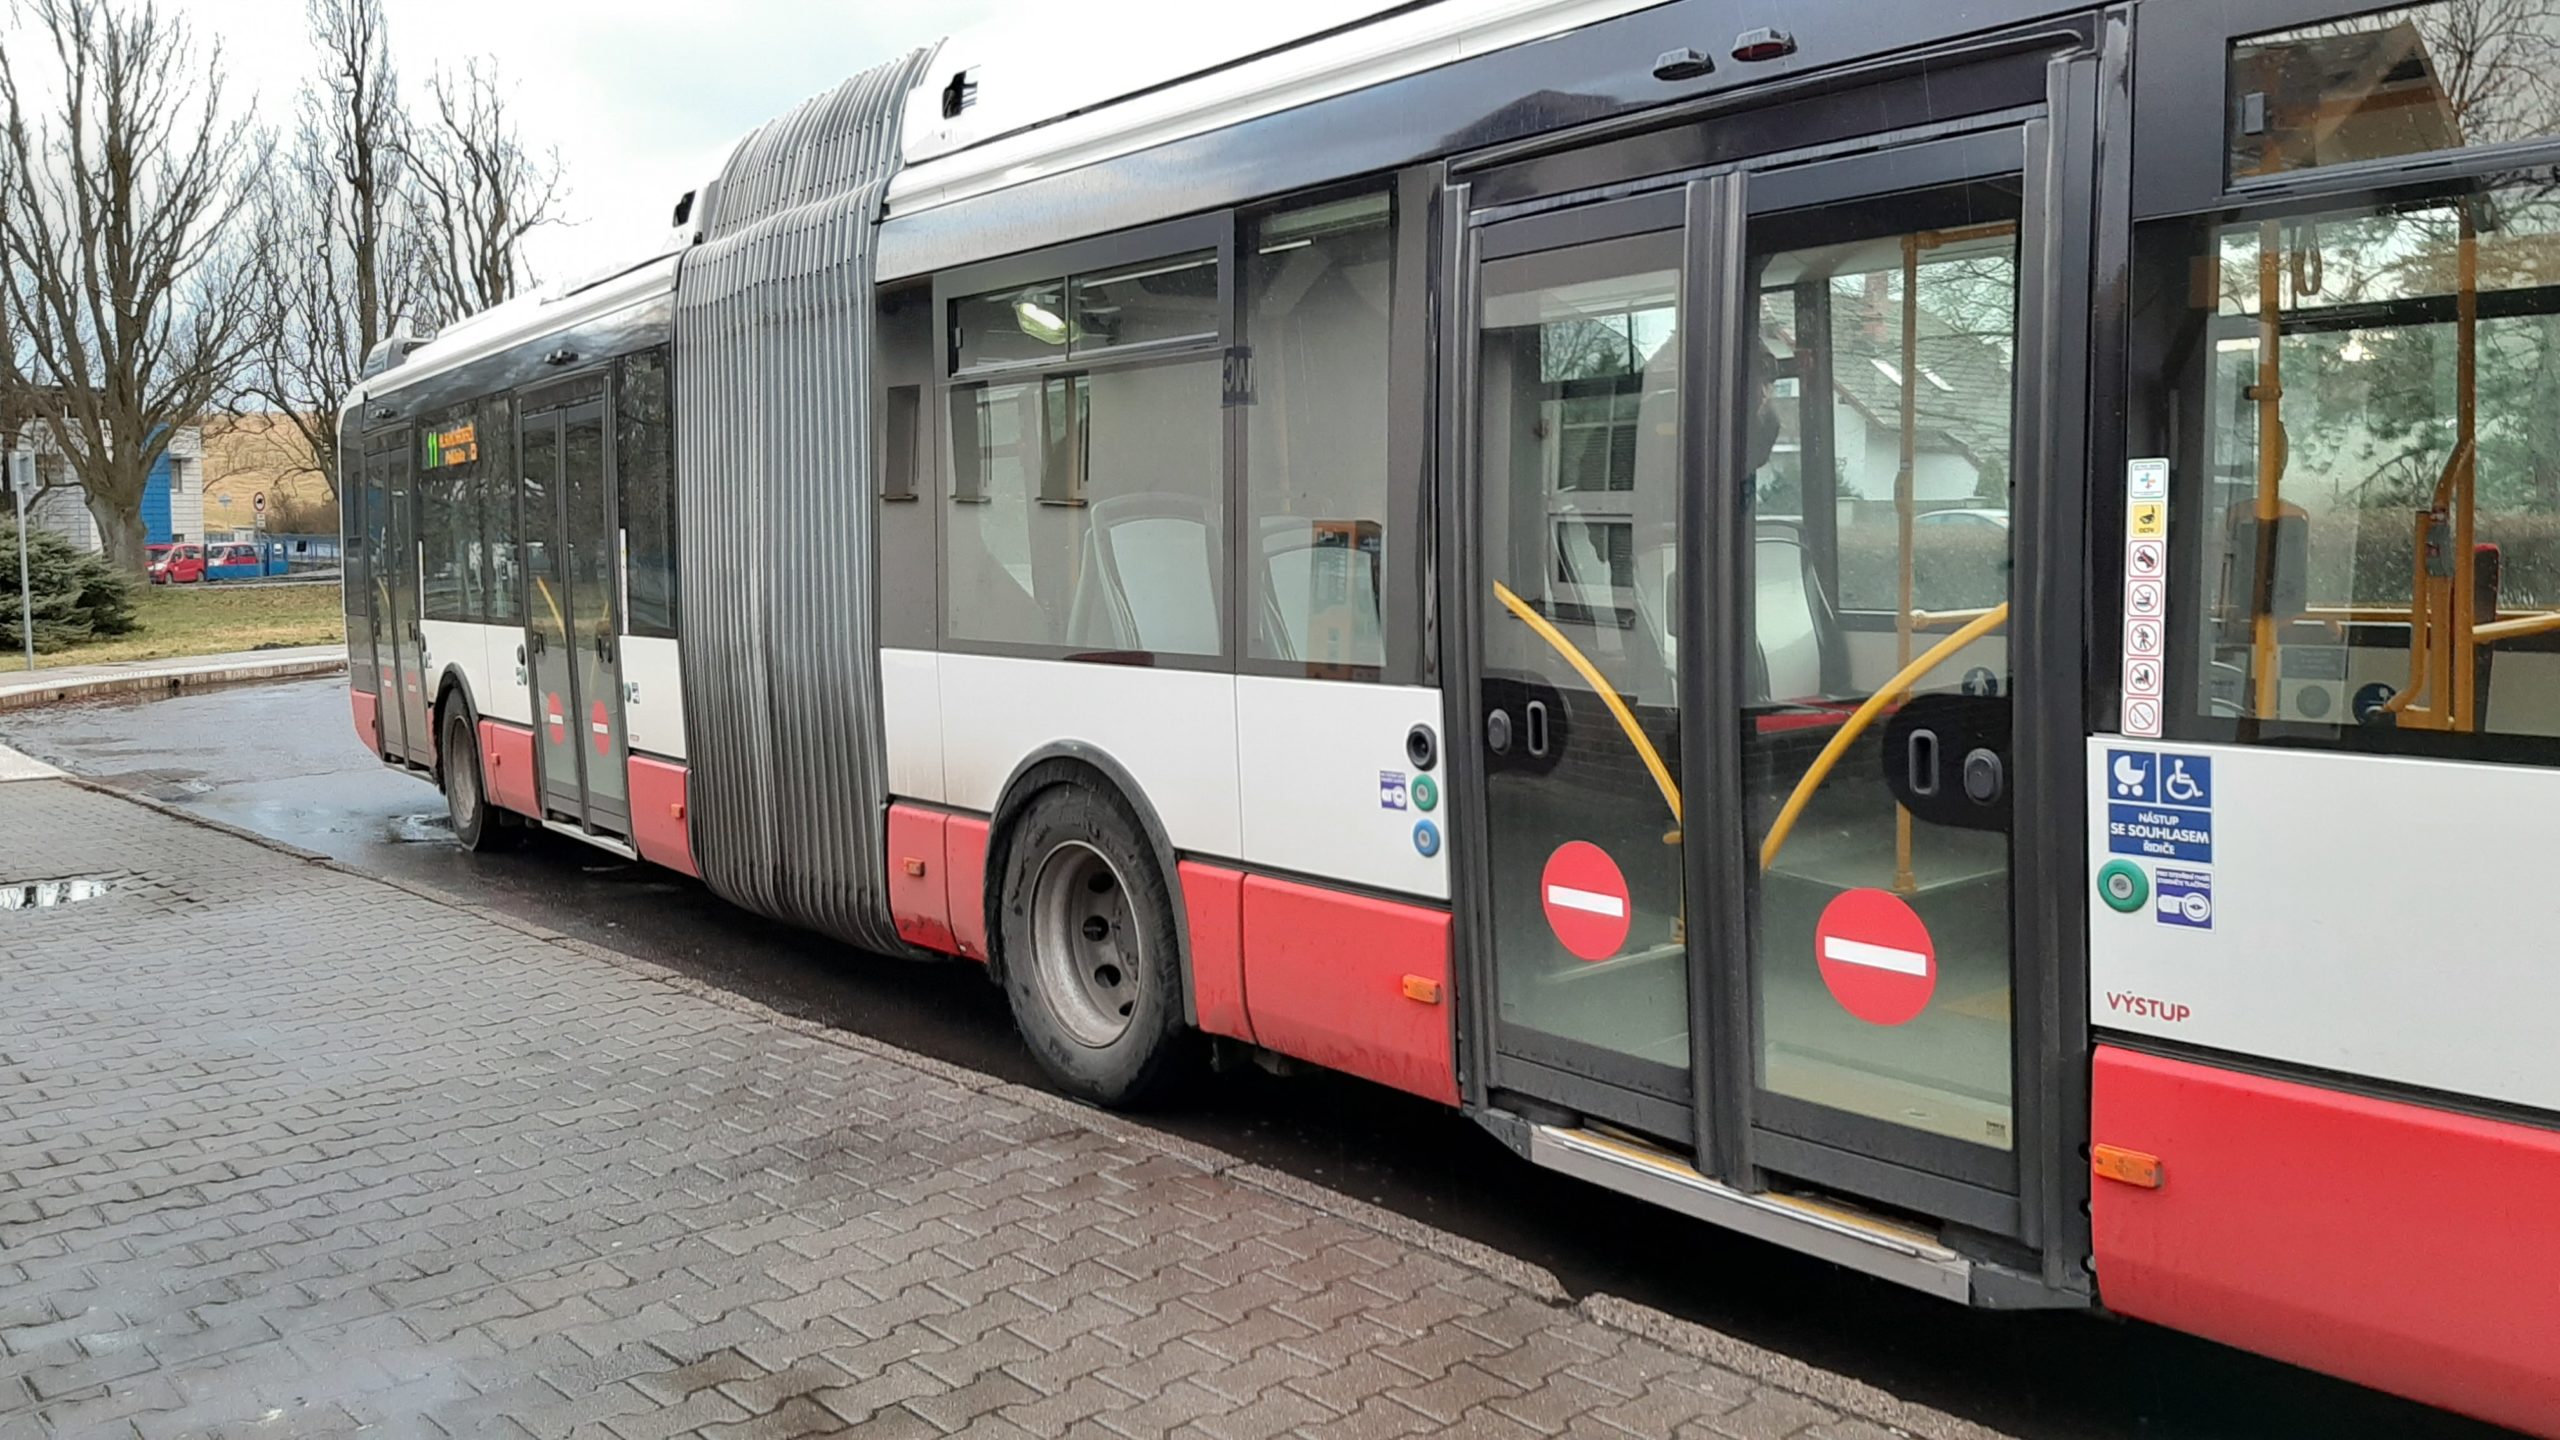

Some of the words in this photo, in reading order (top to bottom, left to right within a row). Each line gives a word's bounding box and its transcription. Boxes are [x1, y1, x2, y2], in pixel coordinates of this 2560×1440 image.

[2138, 810, 2180, 826] NÁSTUP
[2110, 822, 2126, 836] SE
[2128, 824, 2210, 845] SOUHLASEM
[2143, 840, 2176, 855] ŘIDIČE
[2106, 990, 2191, 1023] VÝSTUP
